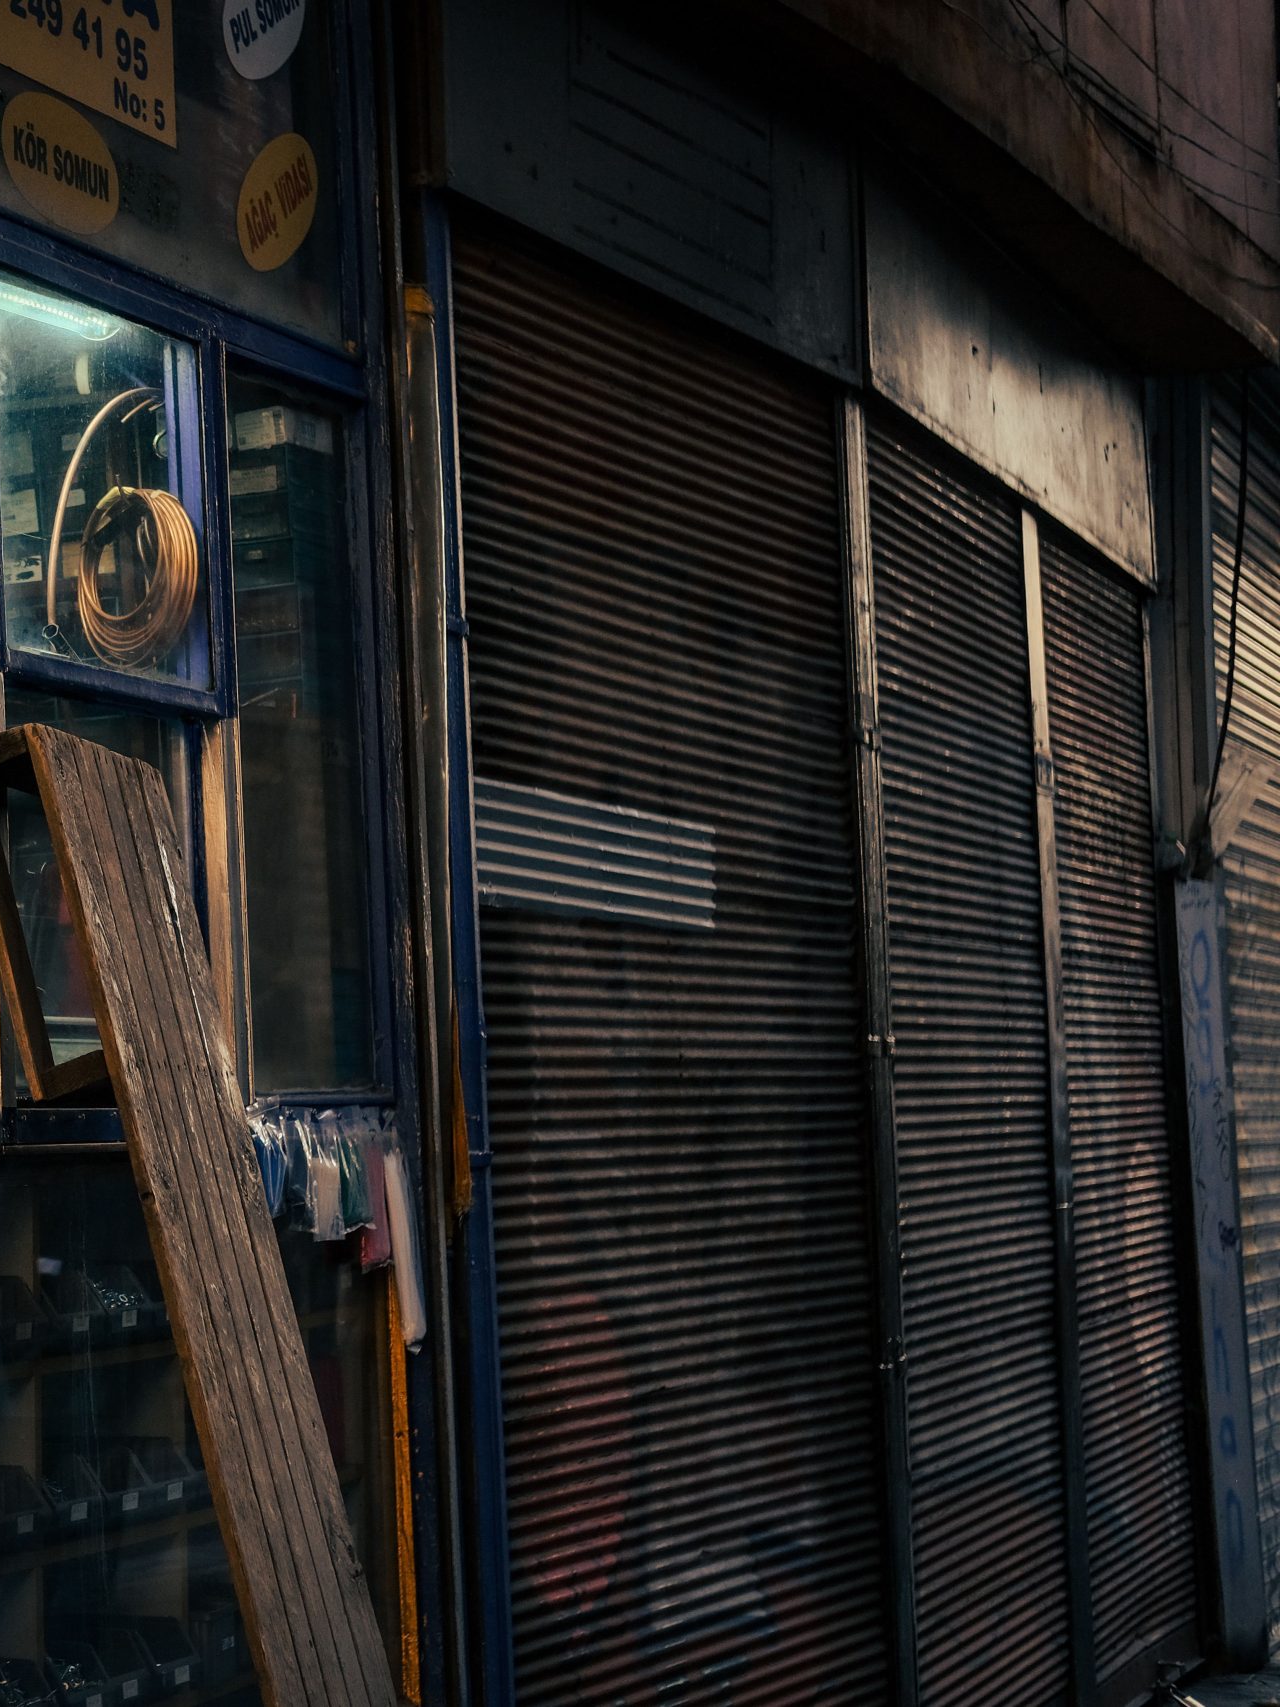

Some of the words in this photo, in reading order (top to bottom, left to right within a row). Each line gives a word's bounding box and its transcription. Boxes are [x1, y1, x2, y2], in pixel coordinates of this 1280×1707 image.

[73, 7, 103, 58] 41
[115, 28, 148, 81] 95
[230, 8, 257, 54] PUL
[256, 0, 299, 34] SOM
[114, 77, 147, 122] No:
[154, 99, 166, 130] 5
[13, 122, 48, 175] KÖR
[53, 145, 109, 202] SOMUN
